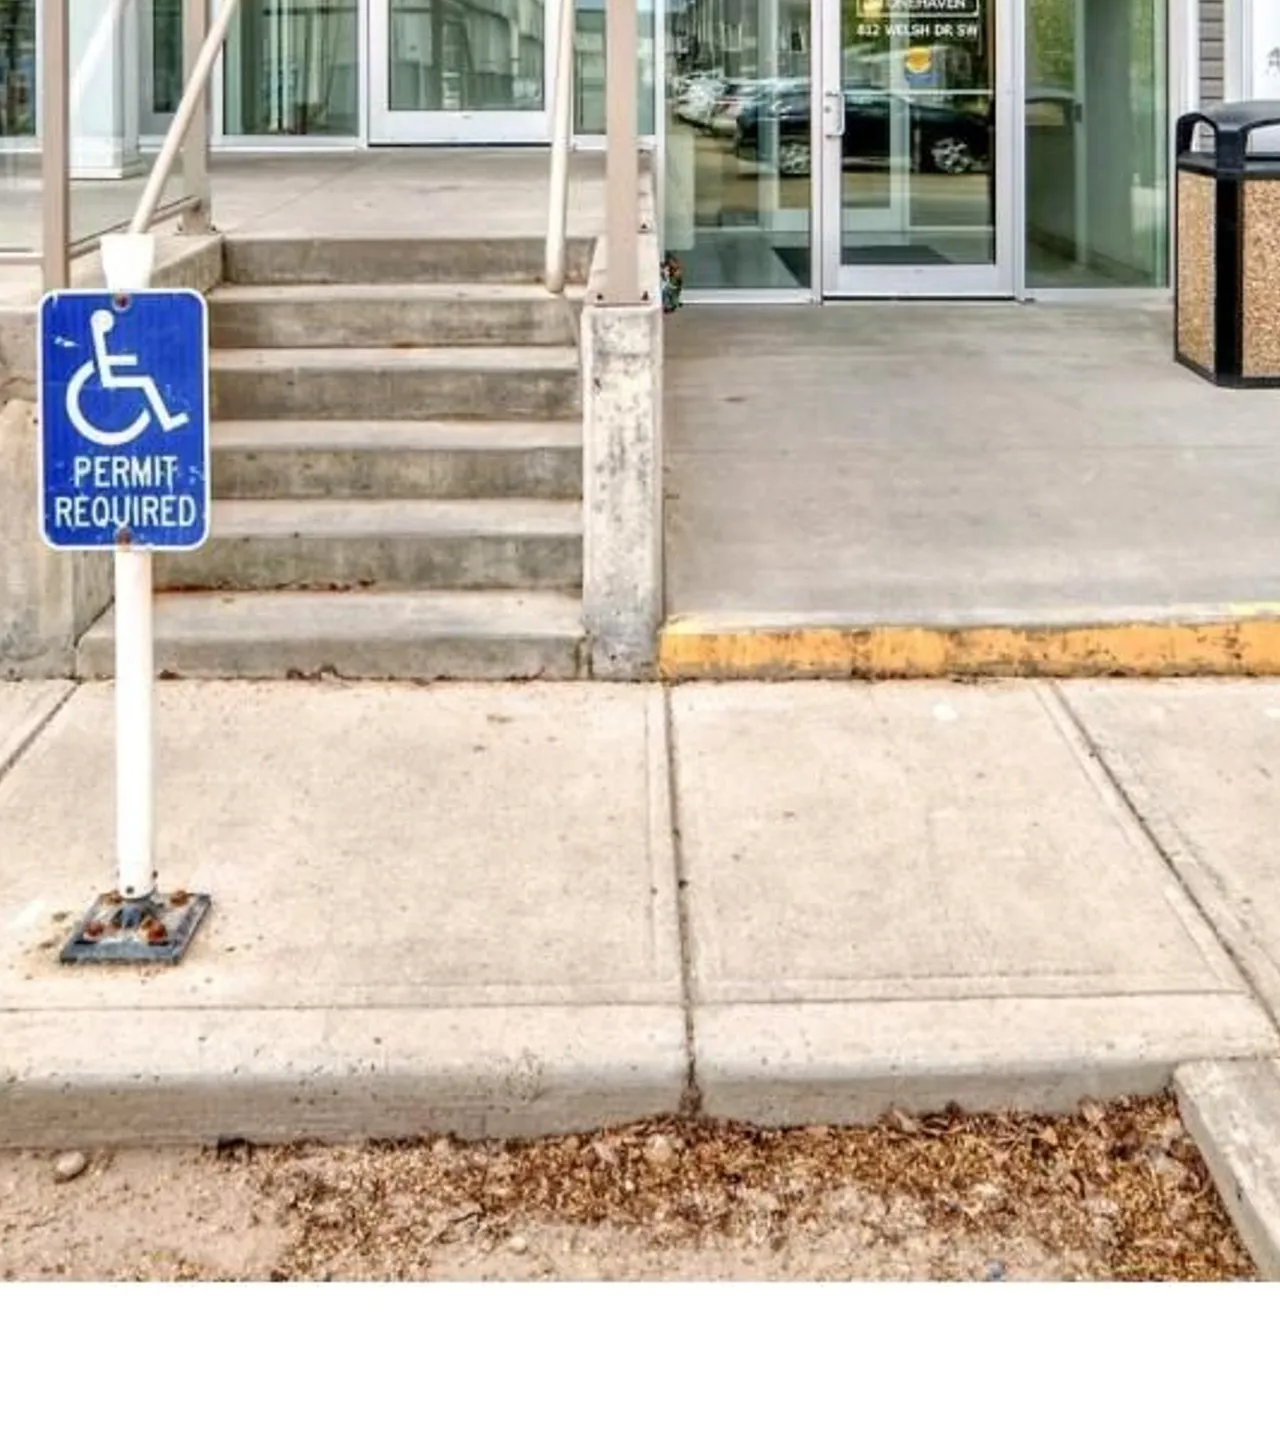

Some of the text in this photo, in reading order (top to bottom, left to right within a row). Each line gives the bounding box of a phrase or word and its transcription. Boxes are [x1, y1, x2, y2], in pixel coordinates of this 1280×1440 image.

[884, 23, 930, 38] WELSH
[933, 23, 954, 38] DR
[956, 23, 978, 38] SW
[73, 456, 178, 488] PERMIT
[55, 495, 196, 527] REQUIRED
